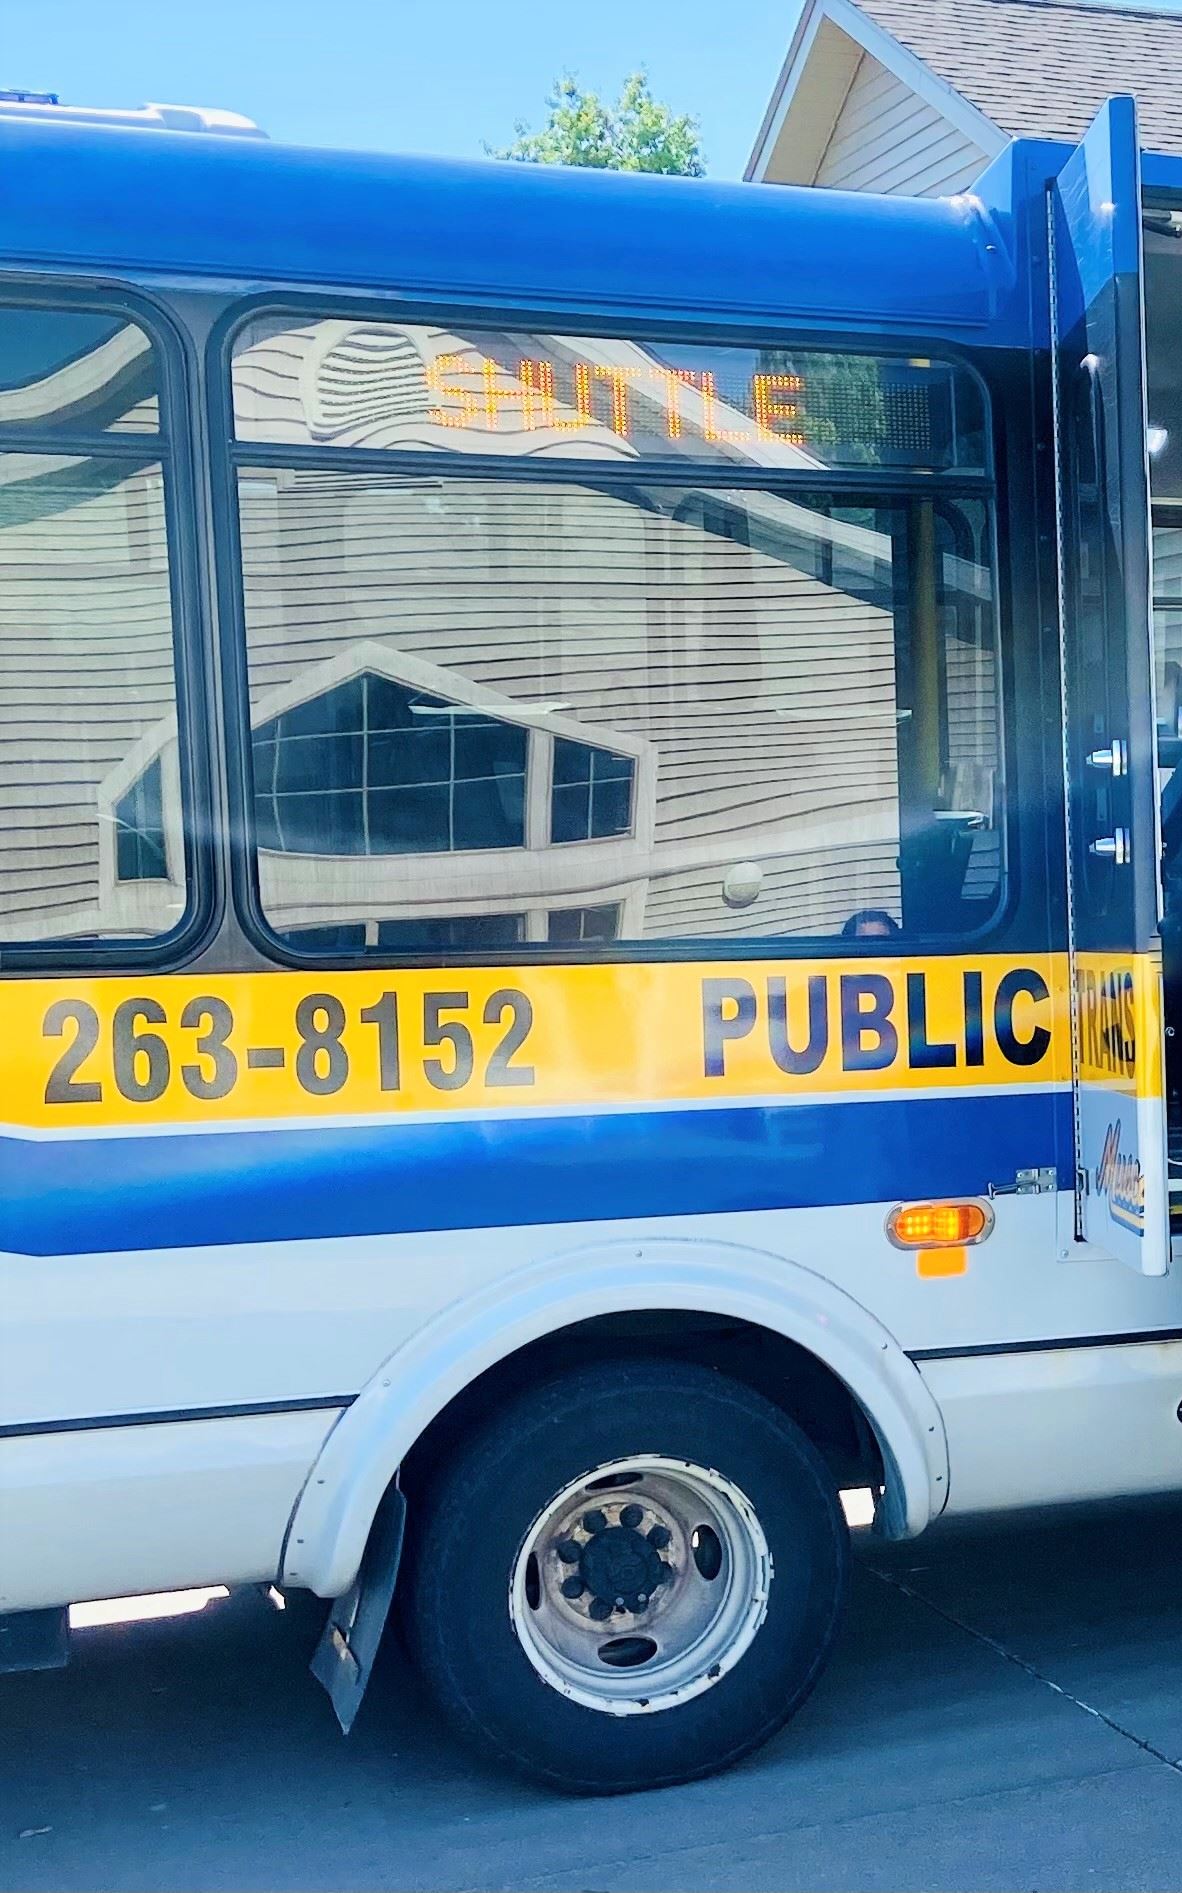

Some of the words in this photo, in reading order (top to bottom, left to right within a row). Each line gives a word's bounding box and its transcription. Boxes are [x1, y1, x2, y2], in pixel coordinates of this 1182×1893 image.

[425, 352, 804, 443] SHUTTLE
[43, 989, 535, 1104] 263-8152
[702, 969, 1052, 1078] PUBLIC
